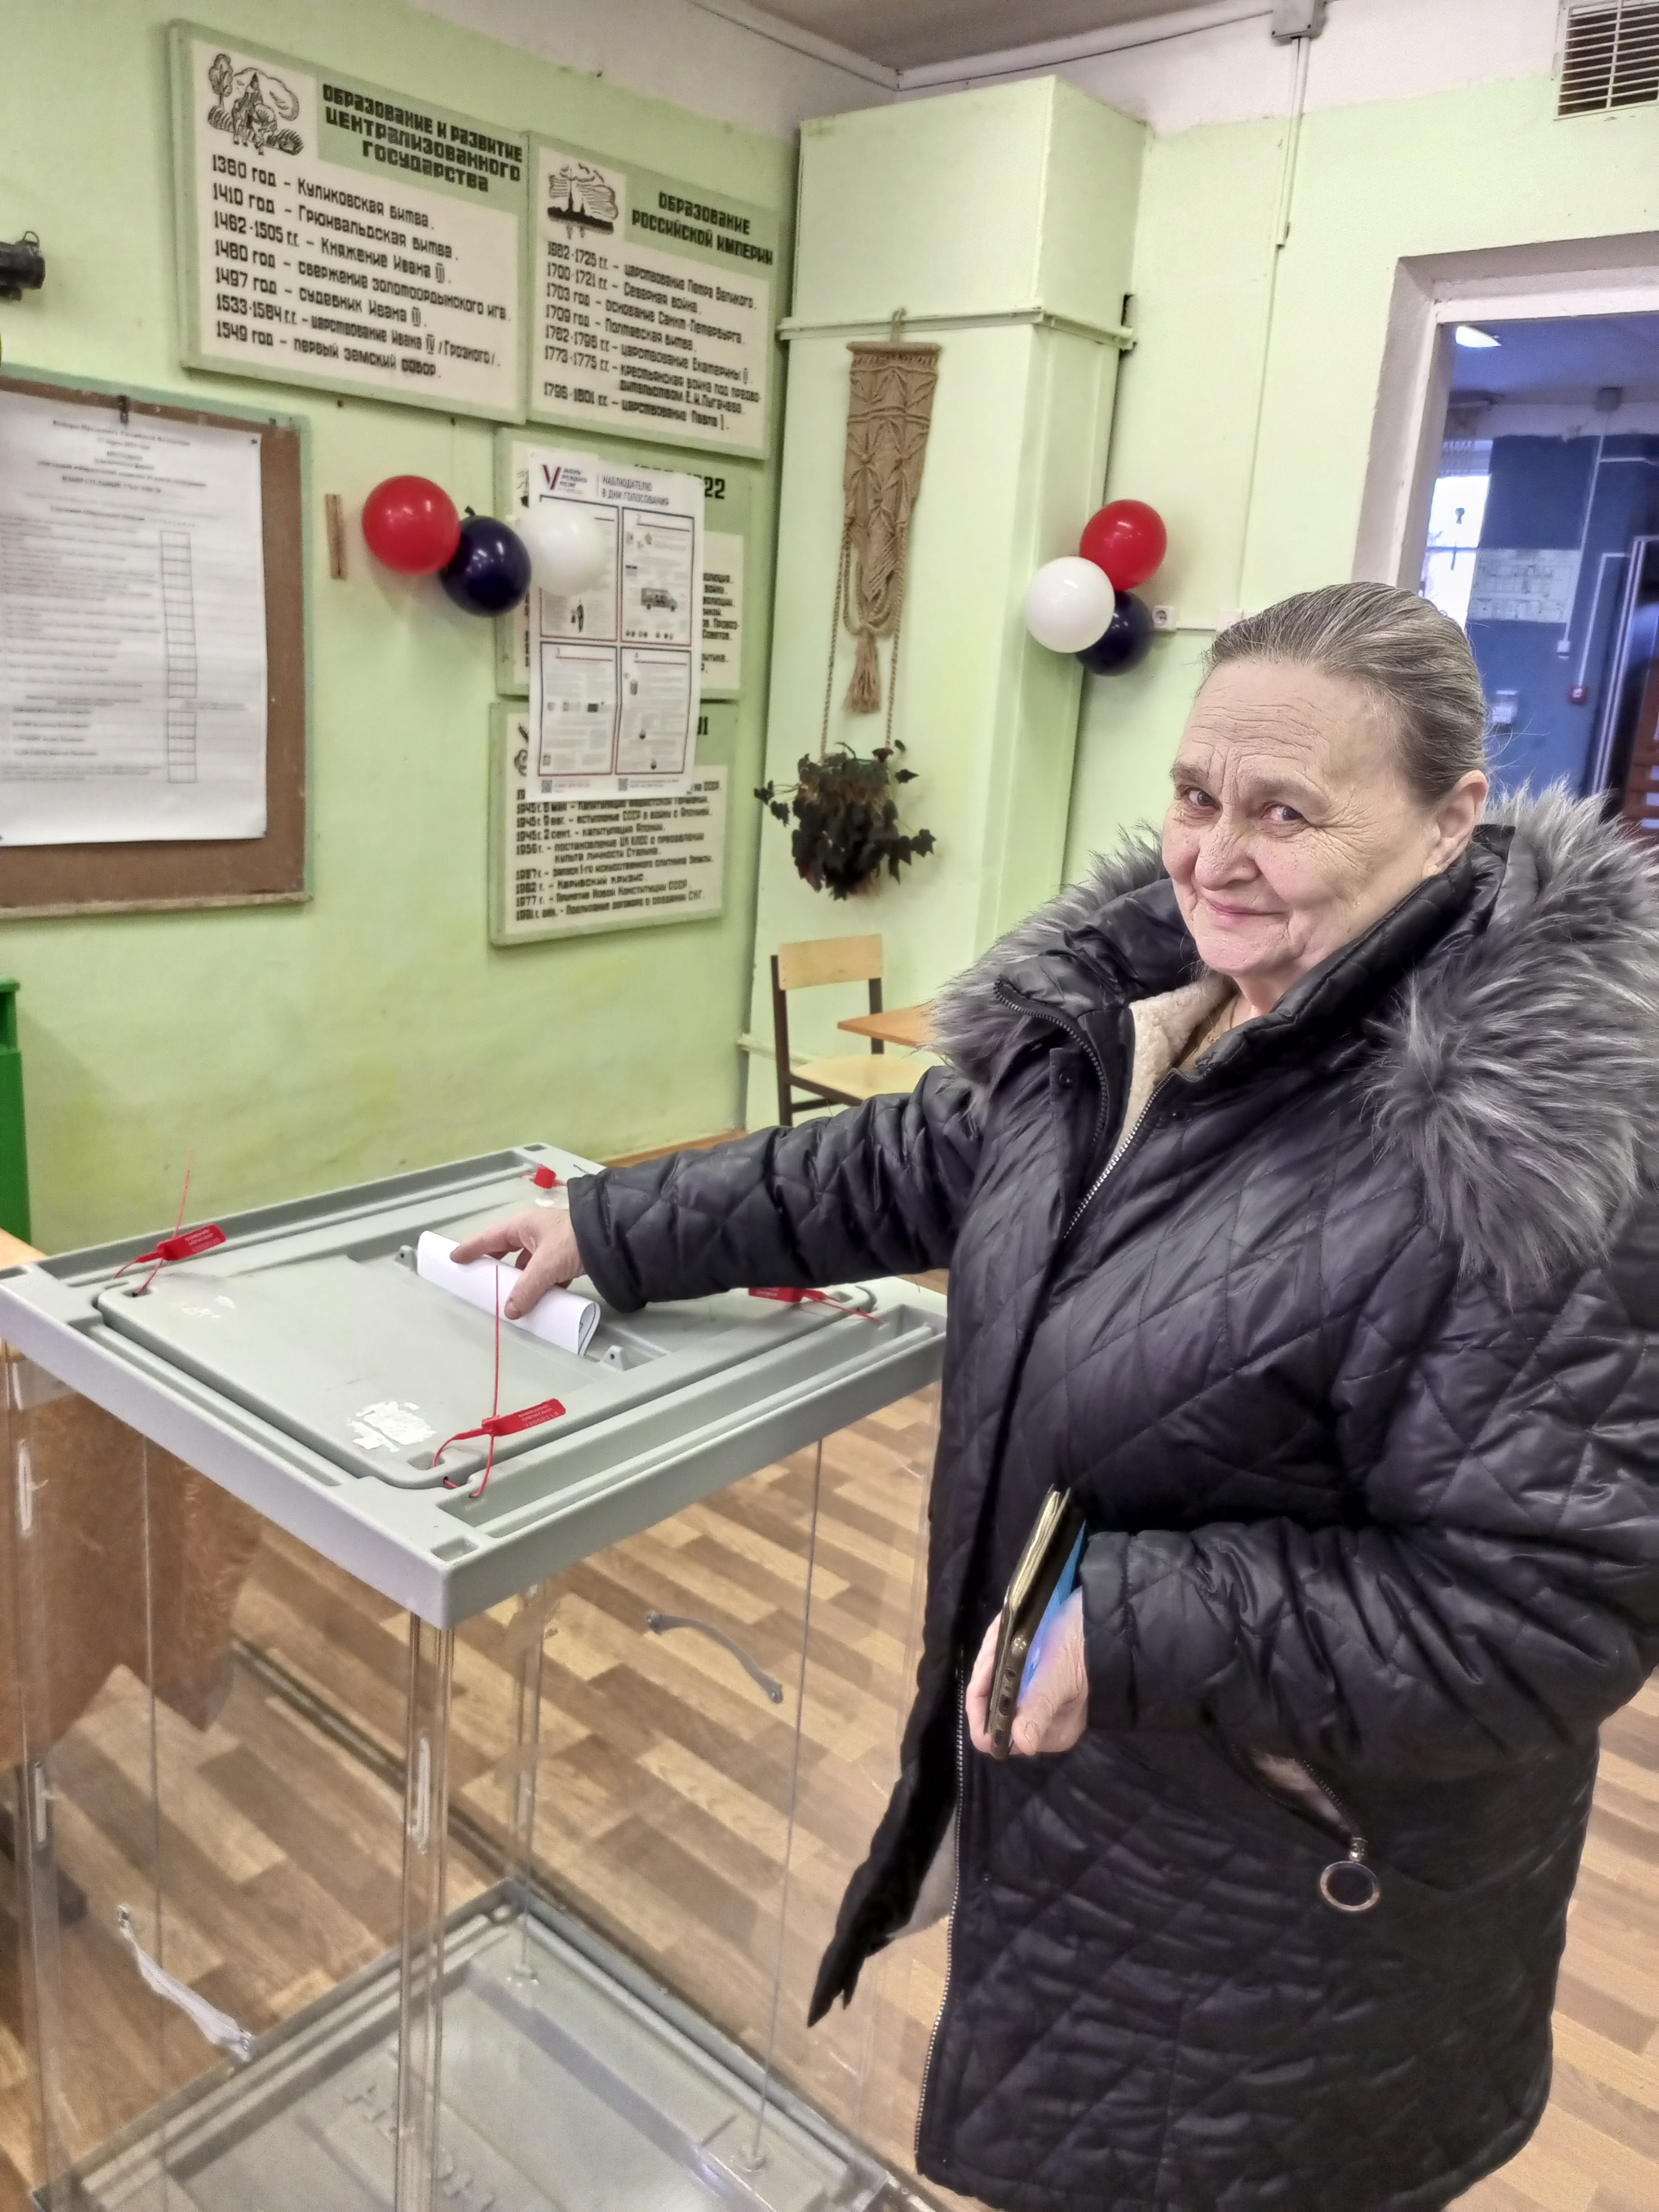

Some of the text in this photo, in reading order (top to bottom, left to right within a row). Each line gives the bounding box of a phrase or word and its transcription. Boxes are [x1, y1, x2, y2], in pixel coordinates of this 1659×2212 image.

[323, 84, 522, 163] ОБРАЗОВАНИЕ И РАЗВИТИЕ
[326, 106, 520, 182] ЦЕНТРАЛИЗОВАННОГО
[213, 154, 246, 178] 1380
[252, 167, 276, 187] год
[298, 177, 384, 216] Куликовская
[362, 140, 488, 192] ГОСУДАРСТВА
[213, 182, 243, 206] 1410
[249, 194, 274, 214] год
[299, 204, 406, 248] Грюнвальдская
[632, 209, 773, 265] РОССИЙСКОЙ ИМПЕРИИ
[659, 191, 750, 235] ОБРАЗОВАНИЕ
[215, 239, 248, 261] 1480
[253, 250, 275, 269] год
[298, 260, 368, 289] свержение
[372, 278, 483, 316] золотоордынского
[321, 237, 387, 268] Княжение
[393, 255, 431, 278] Ивана
[216, 266, 249, 288] 1497
[254, 277, 277, 295] год
[299, 287, 362, 313] судебник
[368, 299, 407, 323] Ивана
[546, 304, 570, 323] 1709
[574, 313, 590, 327] год
[547, 282, 570, 301] 1703
[574, 292, 590, 307] год
[217, 321, 248, 342] 1549
[252, 330, 273, 347] год
[294, 338, 339, 358] первый
[344, 347, 396, 370] земский
